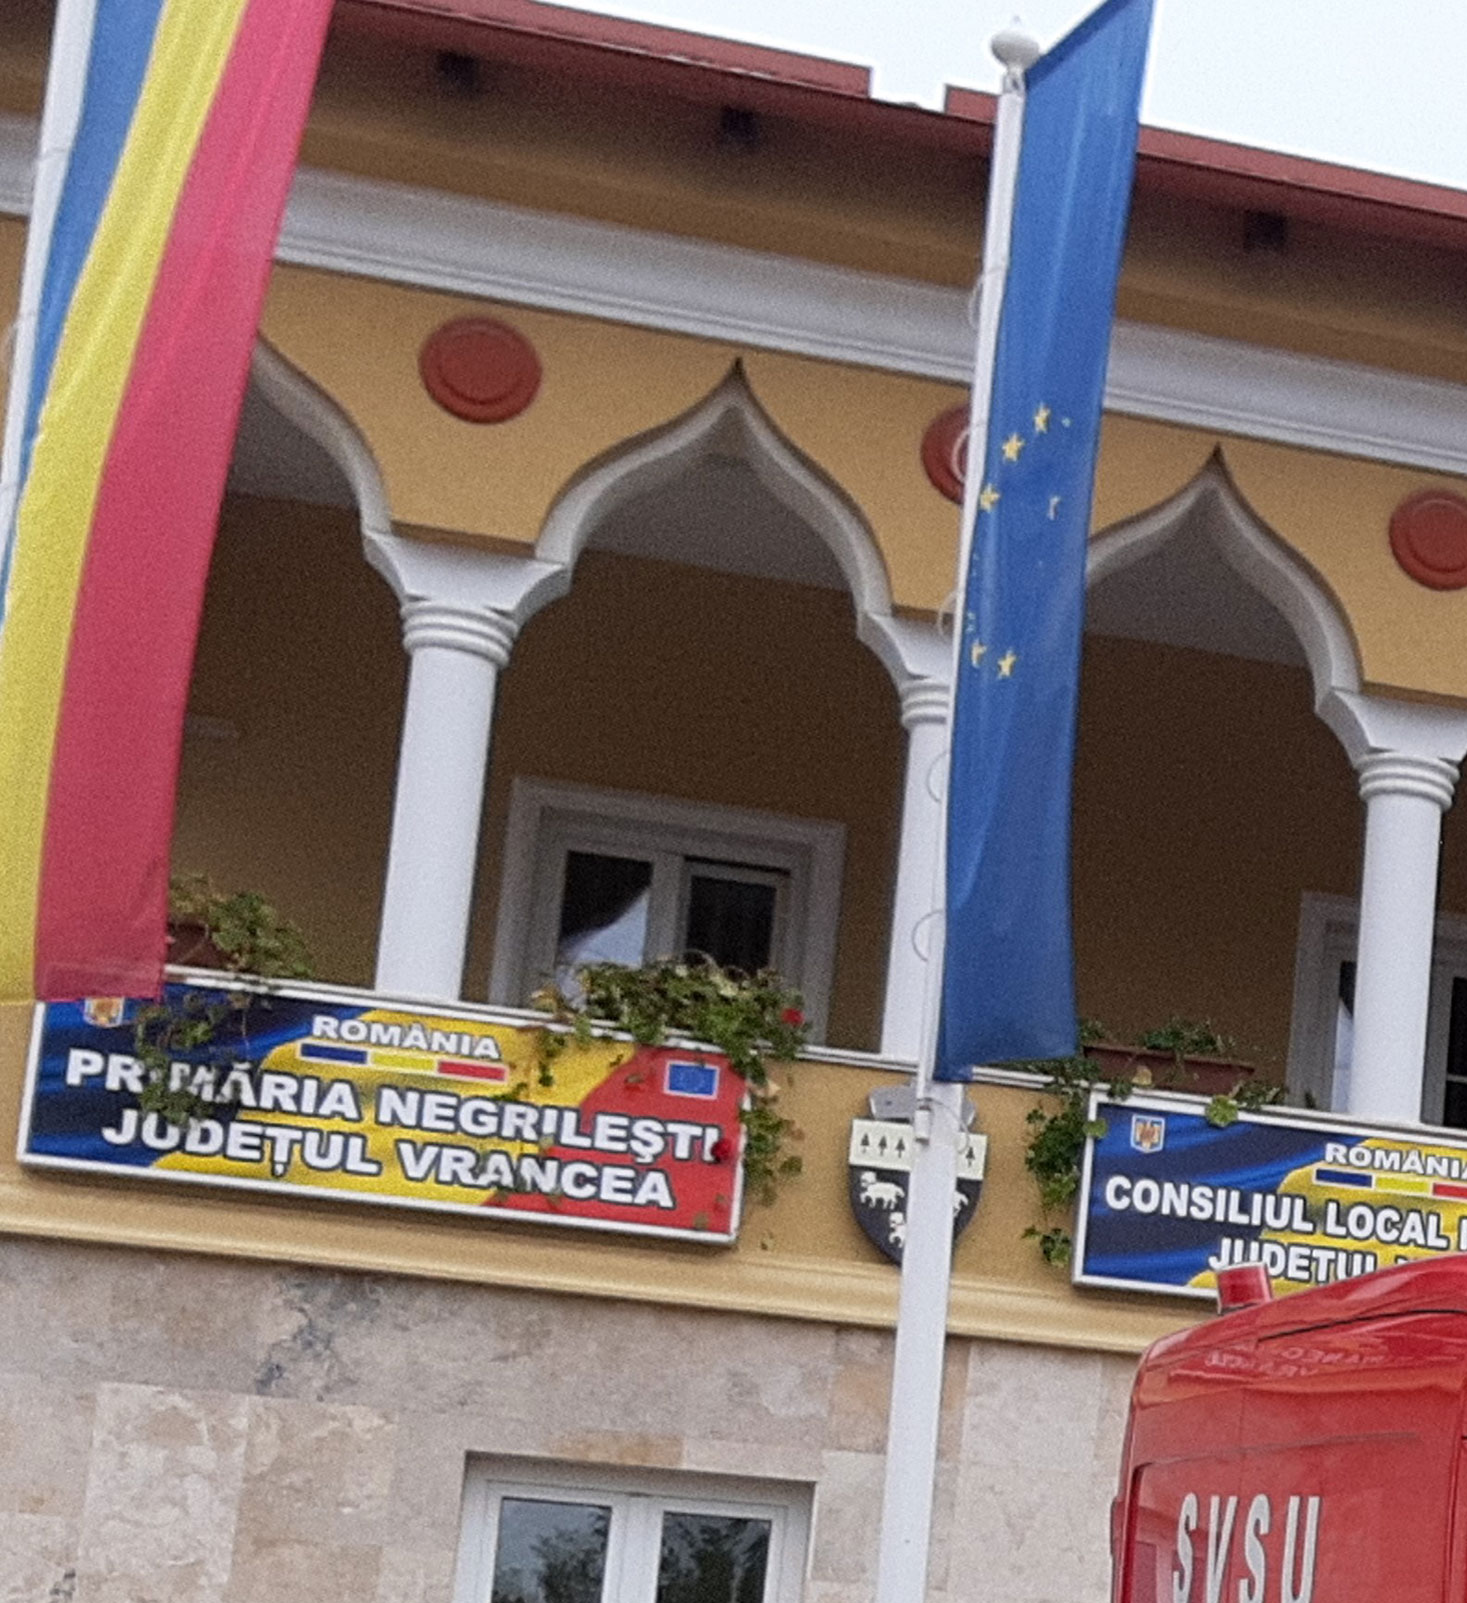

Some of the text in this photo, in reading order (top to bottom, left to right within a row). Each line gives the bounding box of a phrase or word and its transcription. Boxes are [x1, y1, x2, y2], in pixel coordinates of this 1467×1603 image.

[65, 1047, 362, 1121] PRMĂRIA
[397, 1140, 675, 1208] VRANCEA
[1105, 1175, 1315, 1232] CONSILIUL
[1326, 1203, 1449, 1248] LOCAL
